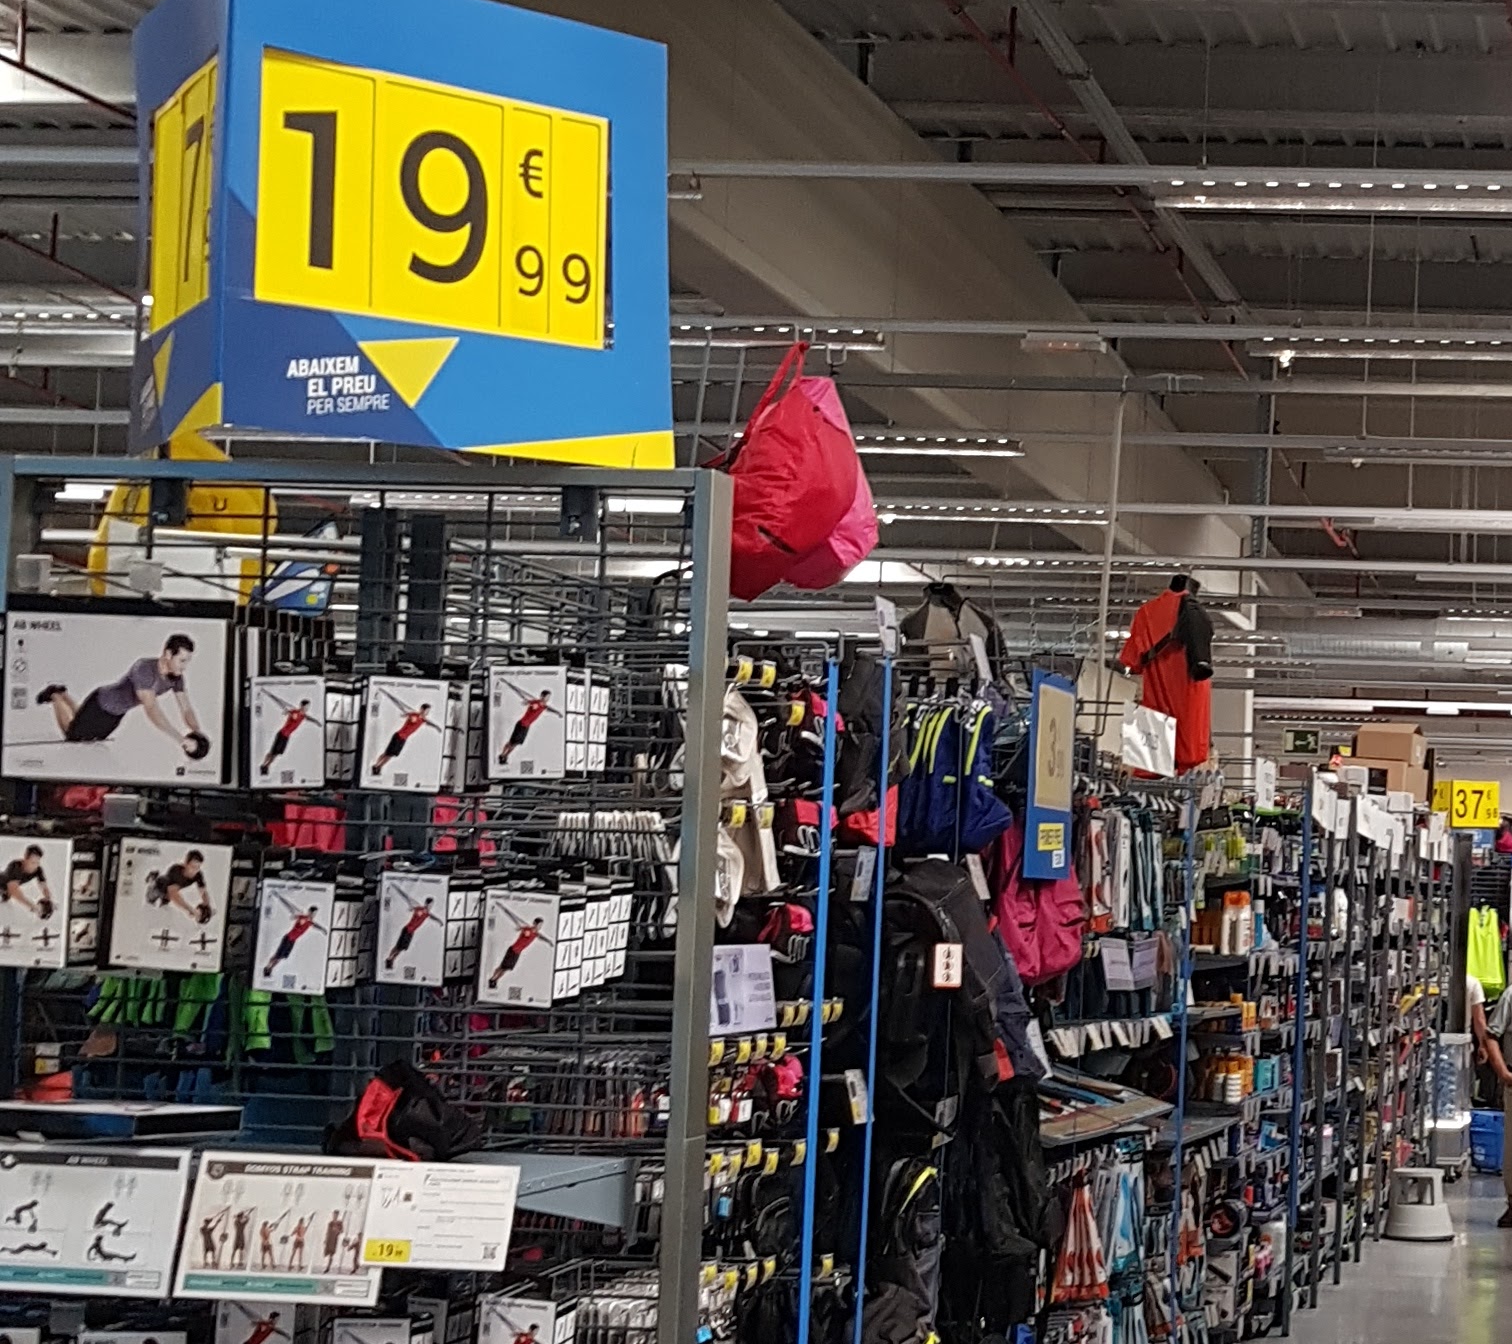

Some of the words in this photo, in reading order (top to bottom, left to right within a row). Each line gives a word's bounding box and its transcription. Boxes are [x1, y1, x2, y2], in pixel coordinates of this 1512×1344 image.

[286, 355, 360, 379] ABAIXEM
[307, 377, 329, 398] EL
[331, 374, 377, 396] PREU
[306, 397, 335, 416] PER
[336, 393, 391, 414] SEMPRE
[1455, 788, 1485, 820] 37
